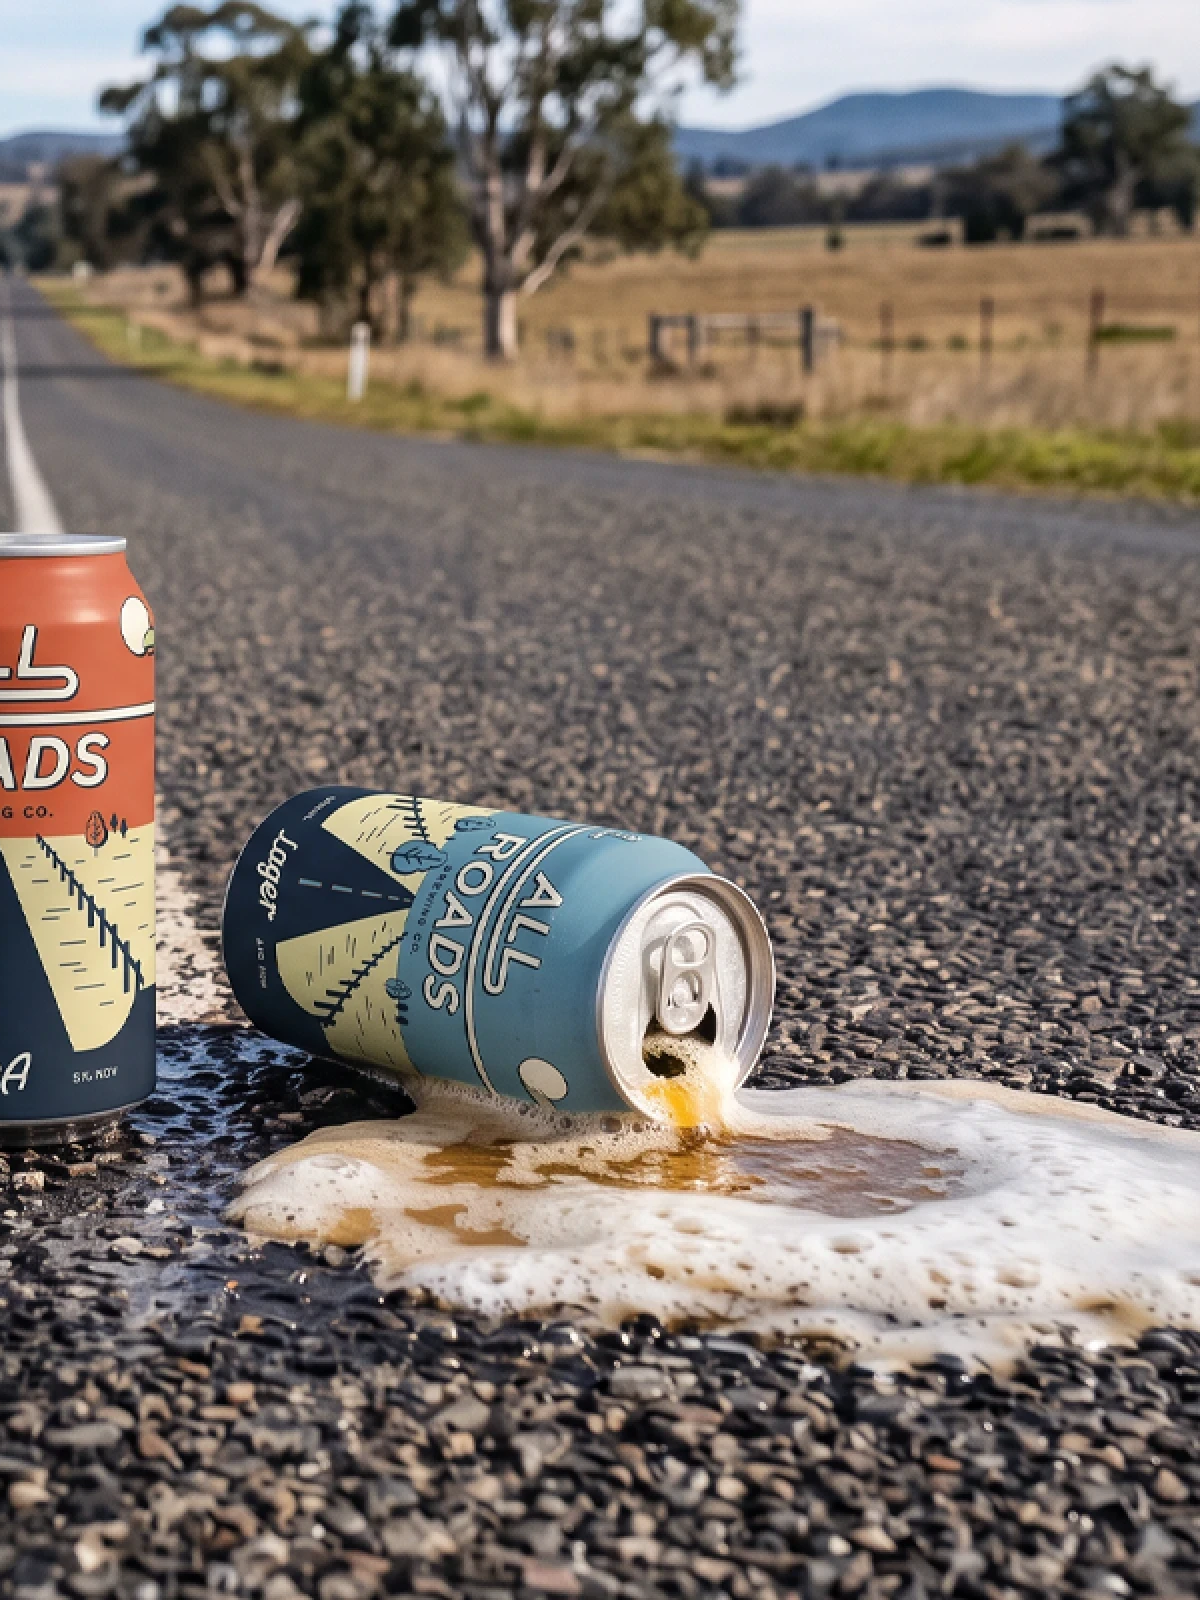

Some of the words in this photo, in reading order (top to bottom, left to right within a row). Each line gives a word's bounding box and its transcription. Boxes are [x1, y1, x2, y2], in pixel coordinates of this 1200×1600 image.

[23, 805, 54, 819] CO.
[256, 828, 299, 922] Lager
[422, 832, 530, 1016] ROADS
[482, 870, 565, 996] ALL
